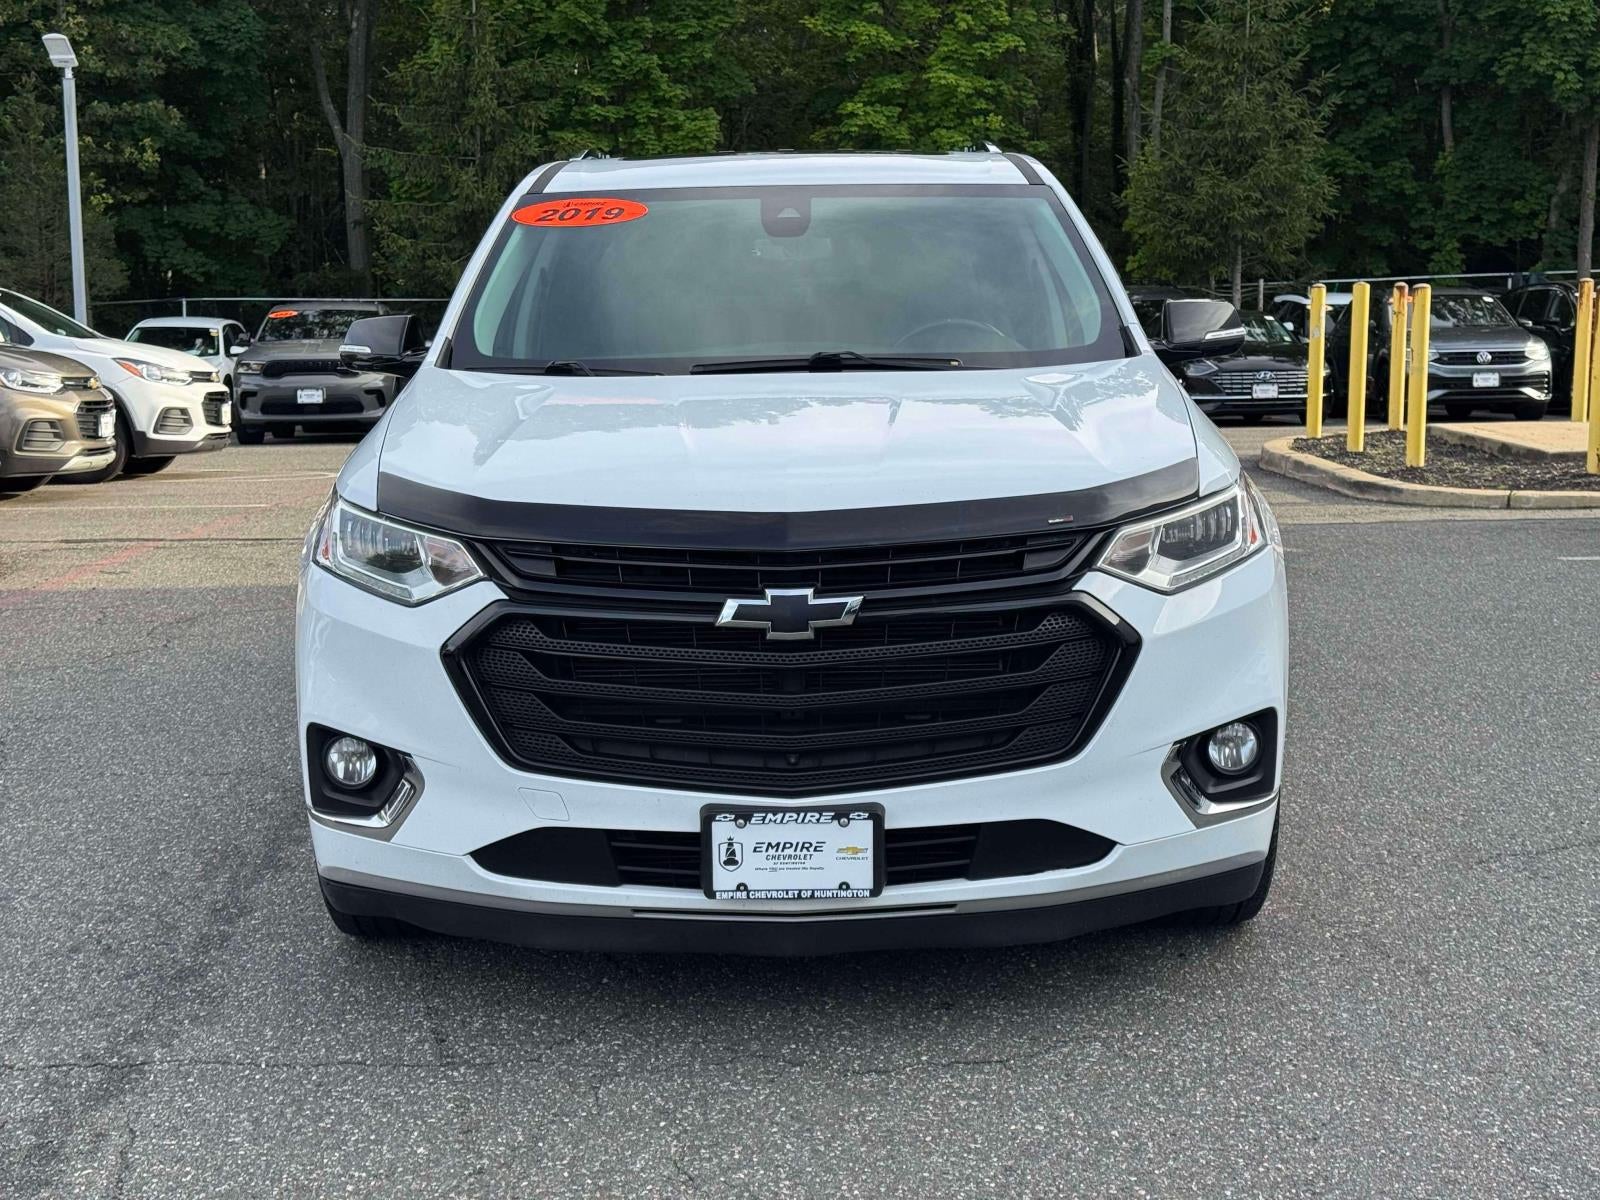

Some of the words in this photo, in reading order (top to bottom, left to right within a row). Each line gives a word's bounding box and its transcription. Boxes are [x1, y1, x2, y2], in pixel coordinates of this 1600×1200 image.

[535, 207, 625, 223] 2019
[749, 812, 835, 825] EMPIRE
[753, 841, 826, 853] EMPIRE
[765, 853, 814, 861] CHEVROLET
[716, 890, 747, 900] EMPIRE
[749, 890, 799, 900] CHEVROLET
[801, 890, 813, 899] OF
[814, 890, 870, 899] HUNTINGTON
